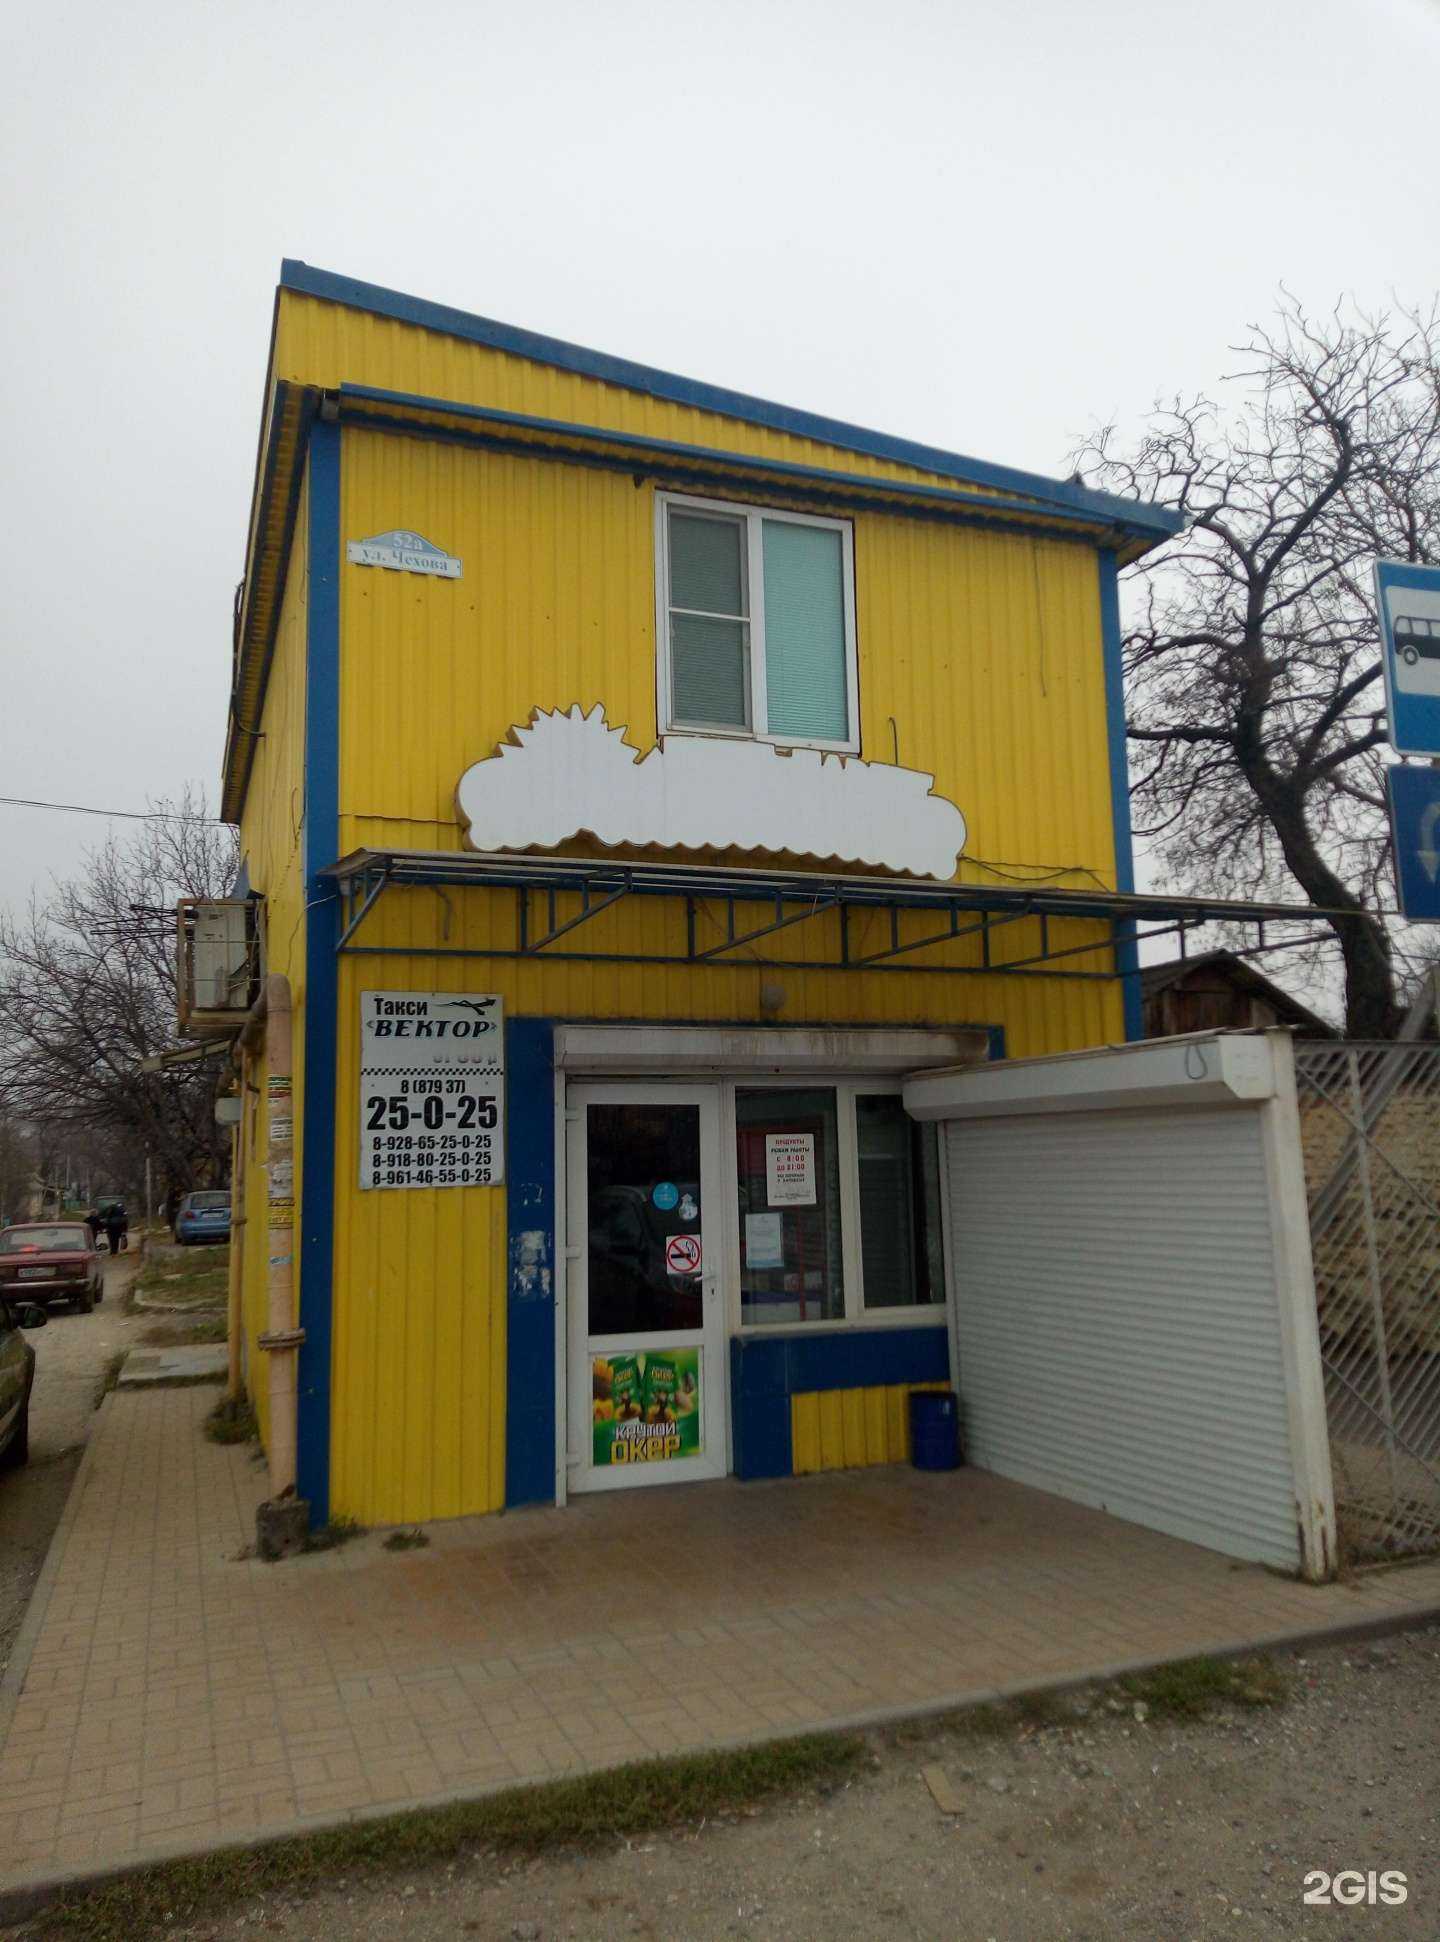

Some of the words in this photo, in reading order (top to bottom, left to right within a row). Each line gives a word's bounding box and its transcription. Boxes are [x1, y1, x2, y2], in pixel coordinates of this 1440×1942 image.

[392, 550, 448, 571] Чехова
[374, 998, 428, 1016] Такси
[401, 1080, 409, 1093] 8
[413, 1080, 443, 1094] (879
[446, 1080, 466, 1094] 37)
[367, 1096, 498, 1130] 25-0-25
[373, 1134, 492, 1151] 8-928-65-25-0-25
[373, 1151, 492, 1168] 8-918-80-25-0-25
[372, 1168, 492, 1185] 8-961-46-55-0-25
